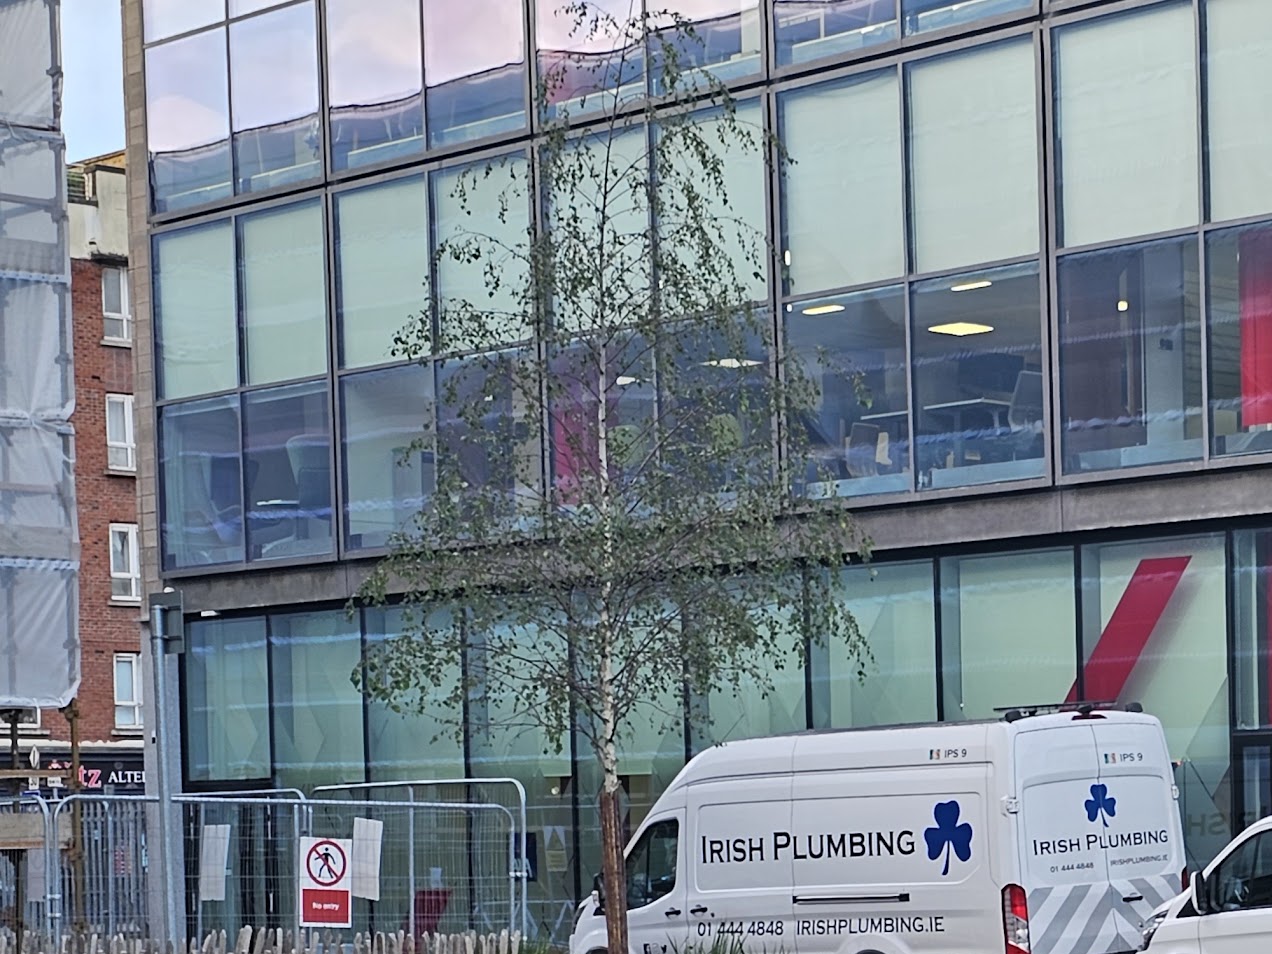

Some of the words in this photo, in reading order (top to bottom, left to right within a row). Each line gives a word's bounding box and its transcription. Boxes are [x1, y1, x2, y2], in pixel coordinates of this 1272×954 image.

[944, 749, 959, 759] IPS
[960, 748, 967, 758] 9
[1120, 753, 1135, 762] IPS
[1136, 752, 1143, 762] 9
[702, 835, 765, 864] IRISH
[773, 830, 916, 861] PLUMBING
[1032, 838, 1081, 856] IRISH
[1086, 830, 1169, 850] PLUMBING
[1050, 864, 1059, 873] 01
[1061, 863, 1075, 872] 444
[697, 921, 712, 937] 01
[717, 921, 744, 937] 444
[748, 920, 784, 936] 4848
[796, 916, 945, 936] IRISHPLUMBING.IE
